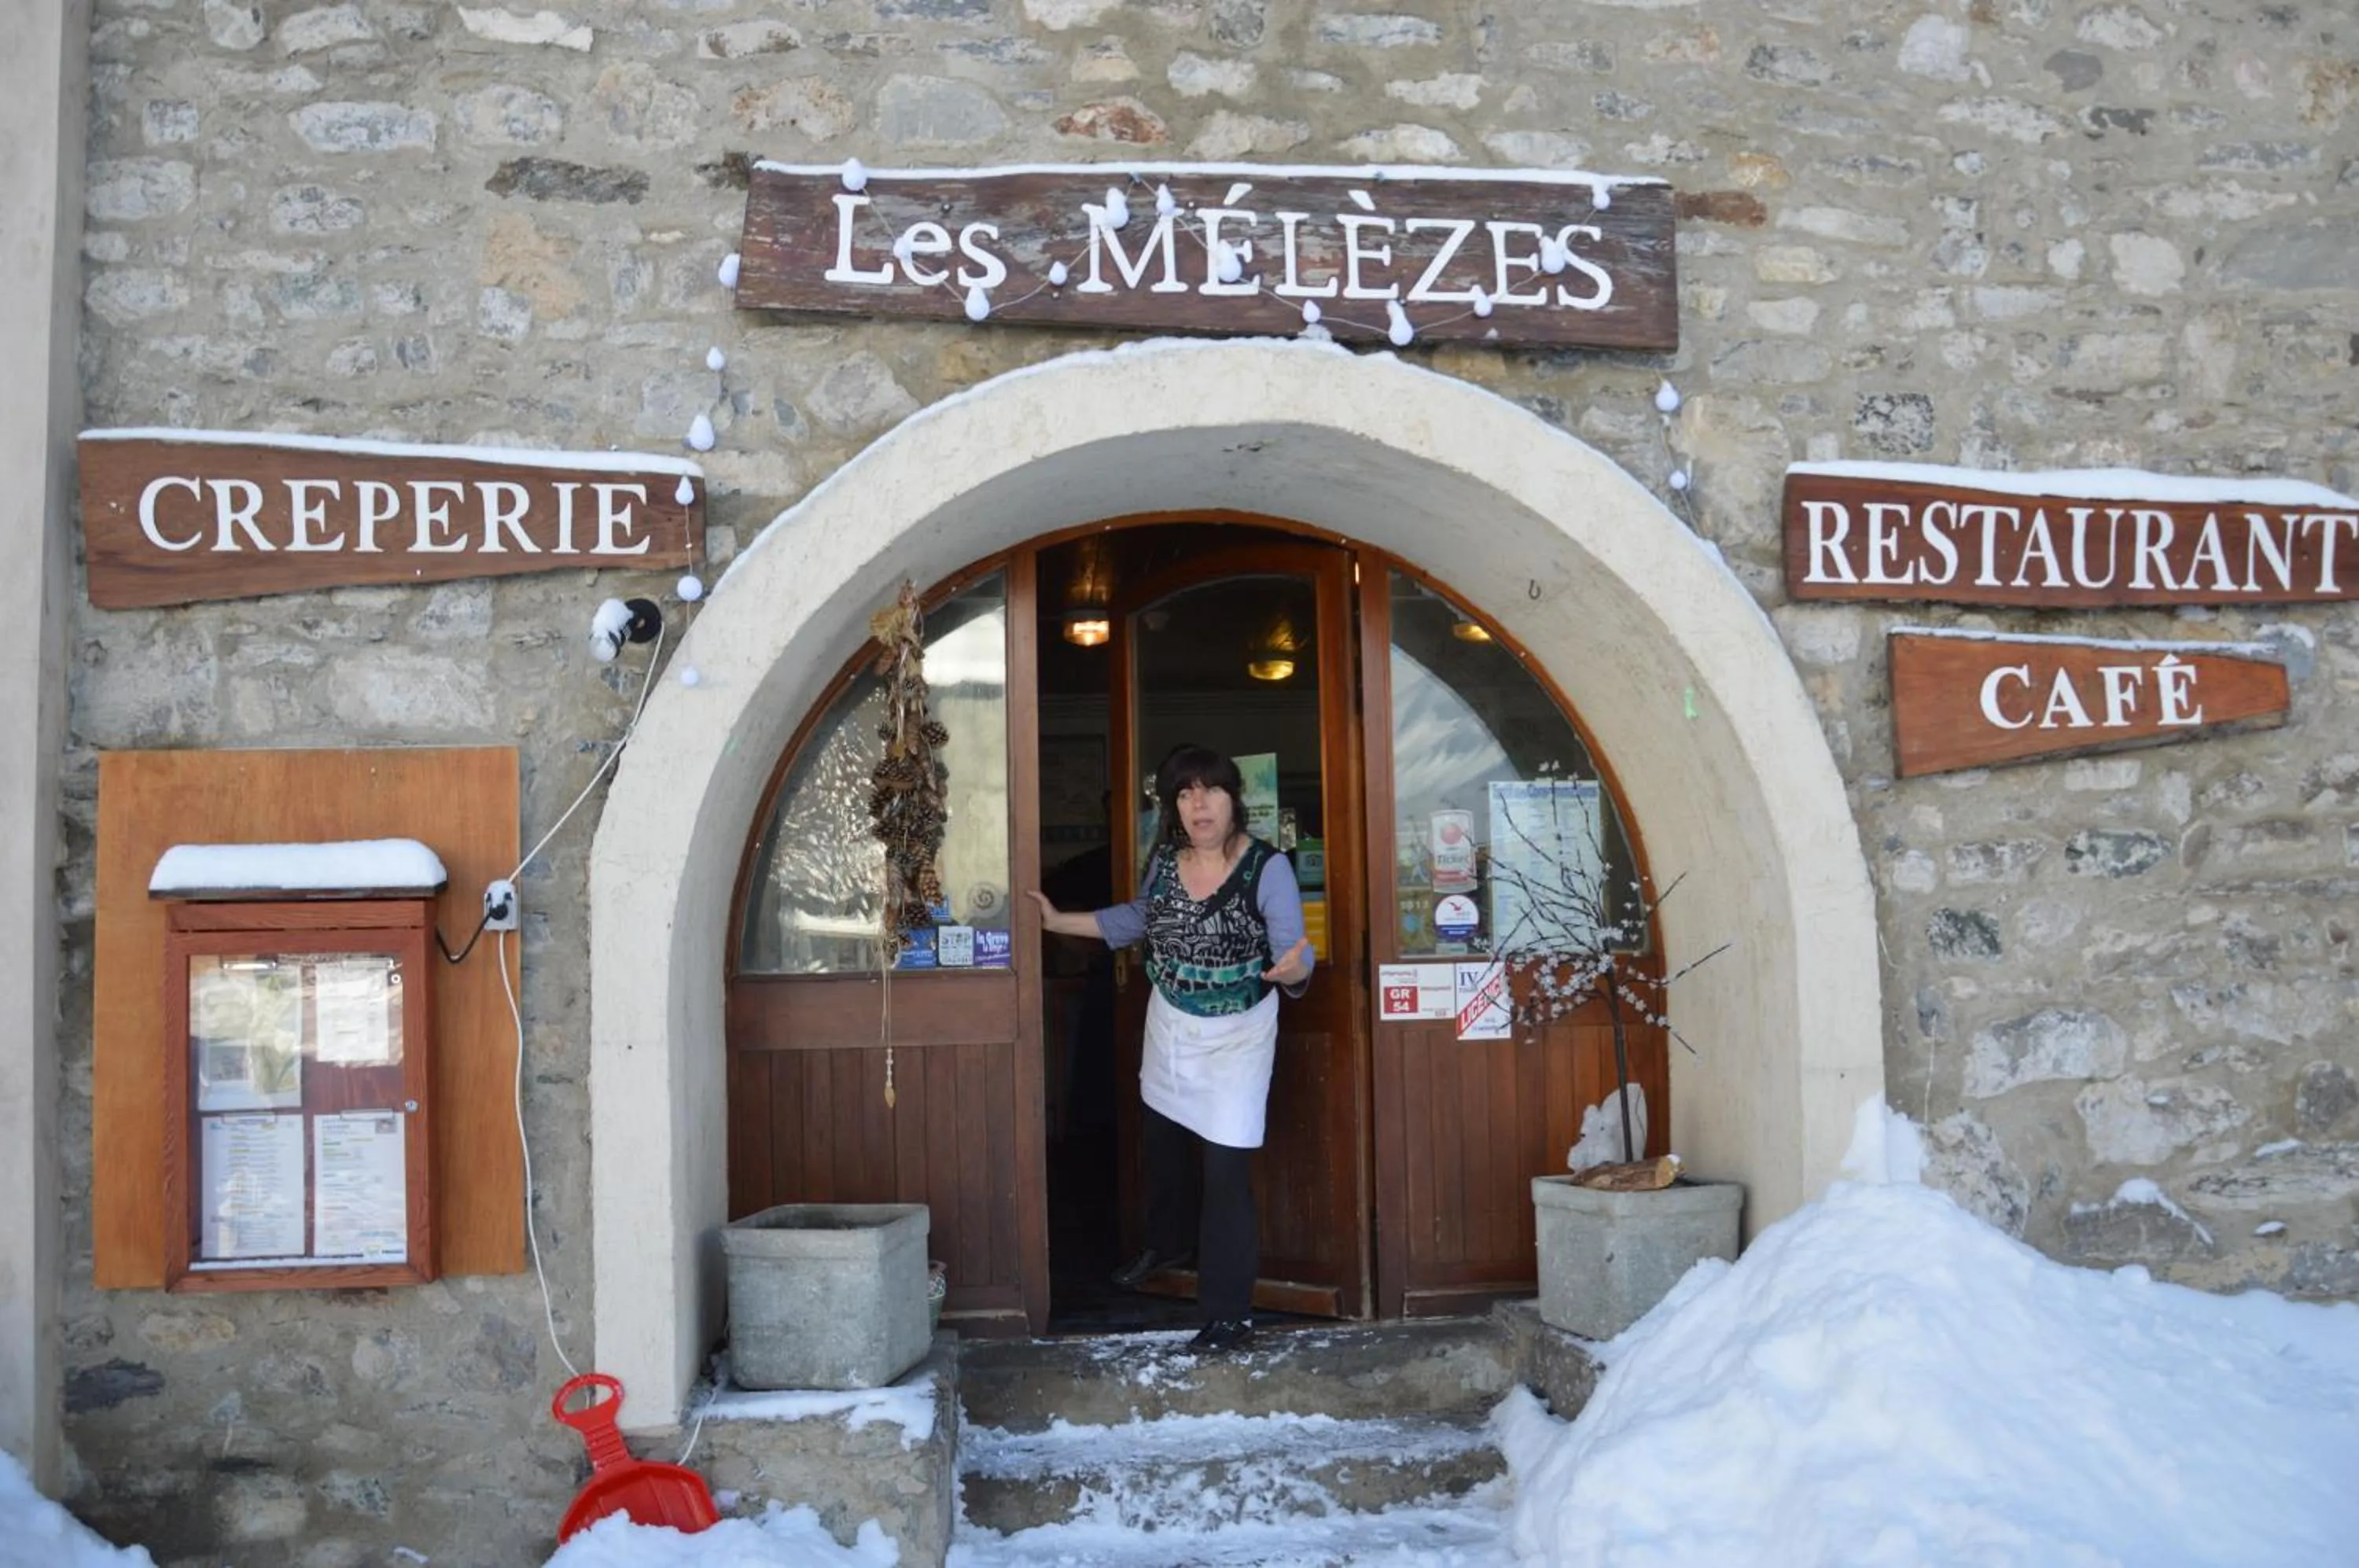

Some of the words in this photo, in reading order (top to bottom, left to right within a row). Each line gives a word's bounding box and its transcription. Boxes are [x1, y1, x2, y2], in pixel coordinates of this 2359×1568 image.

[824, 194, 1007, 289] Les
[1076, 182, 1614, 311] MÉLÈZES
[138, 476, 652, 556] CREPERIE
[1801, 500, 2359, 594] RESTAURANT
[1389, 988, 1410, 999] GR
[1393, 1001, 1410, 1012] 54
